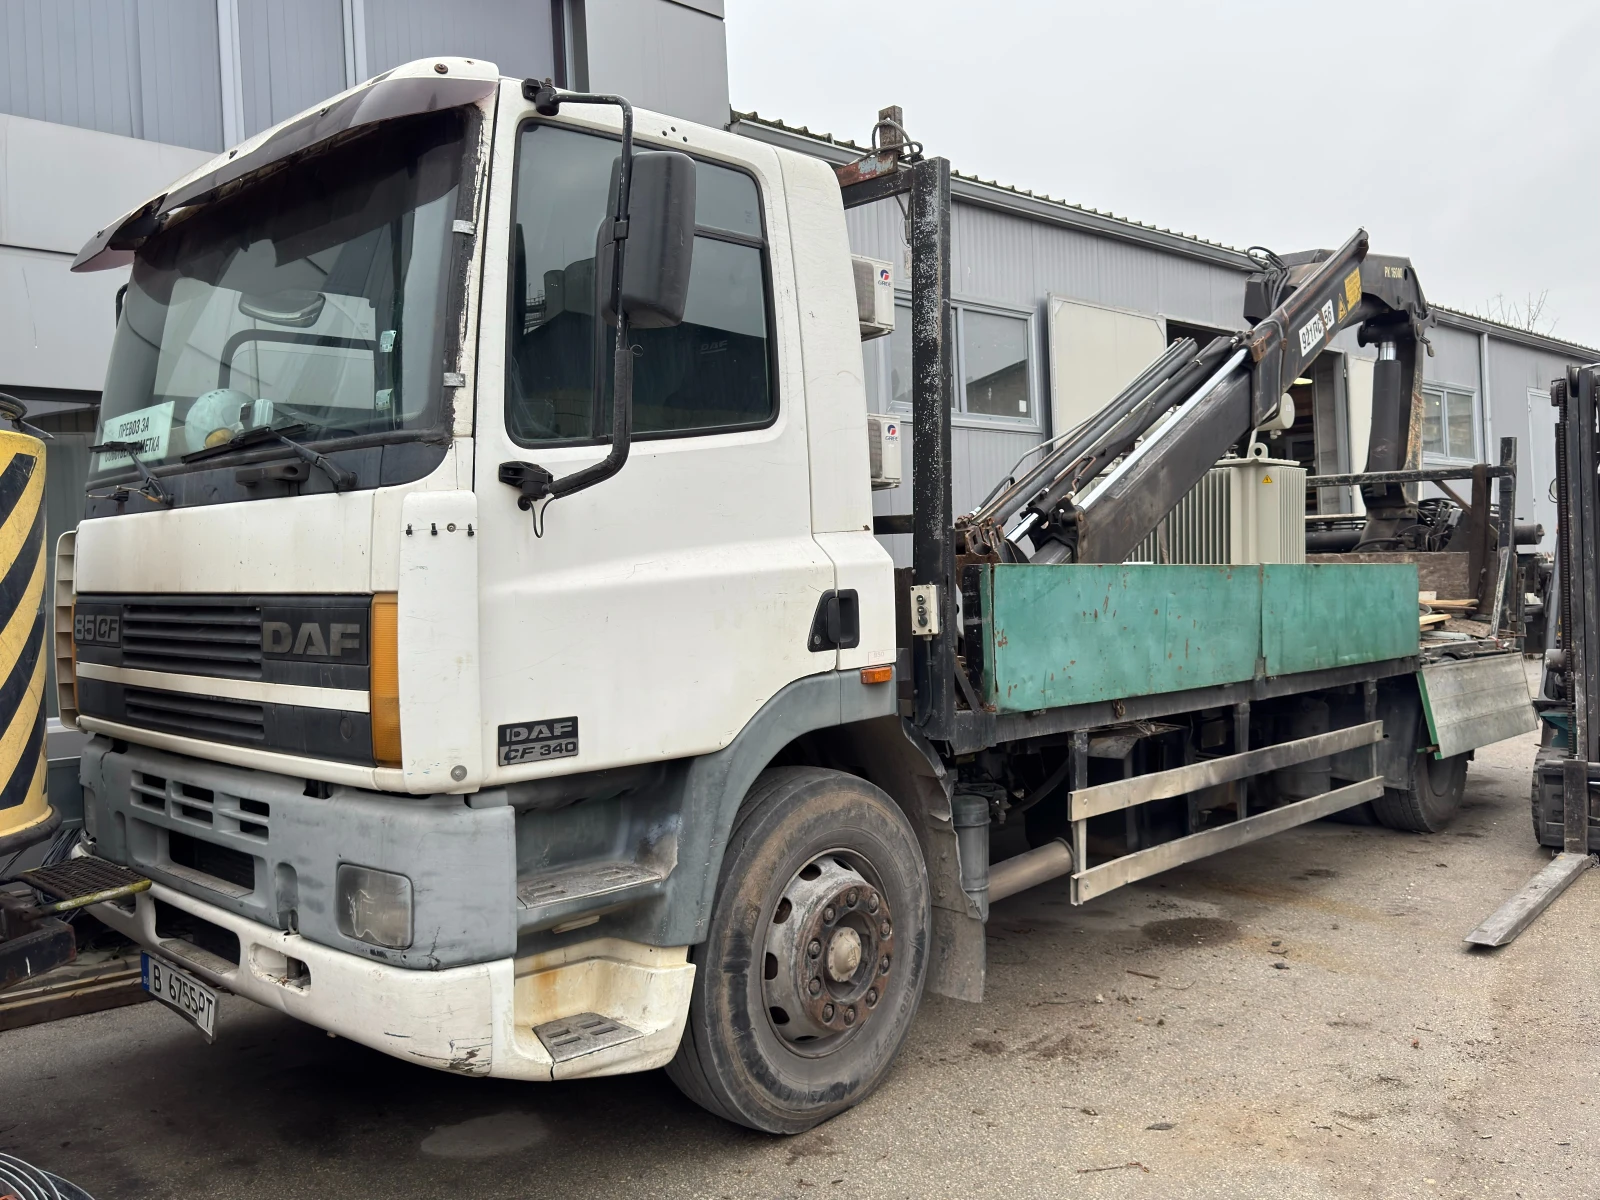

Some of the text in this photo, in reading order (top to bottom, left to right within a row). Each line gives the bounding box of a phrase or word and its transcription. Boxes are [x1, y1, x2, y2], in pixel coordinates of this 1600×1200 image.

[701, 340, 728, 351] DAF
[118, 416, 150, 439] ПРЕВОЗ ЗА
[262, 621, 360, 657] DAF
[506, 721, 573, 742] DAF
[503, 741, 577, 761] CF 340
